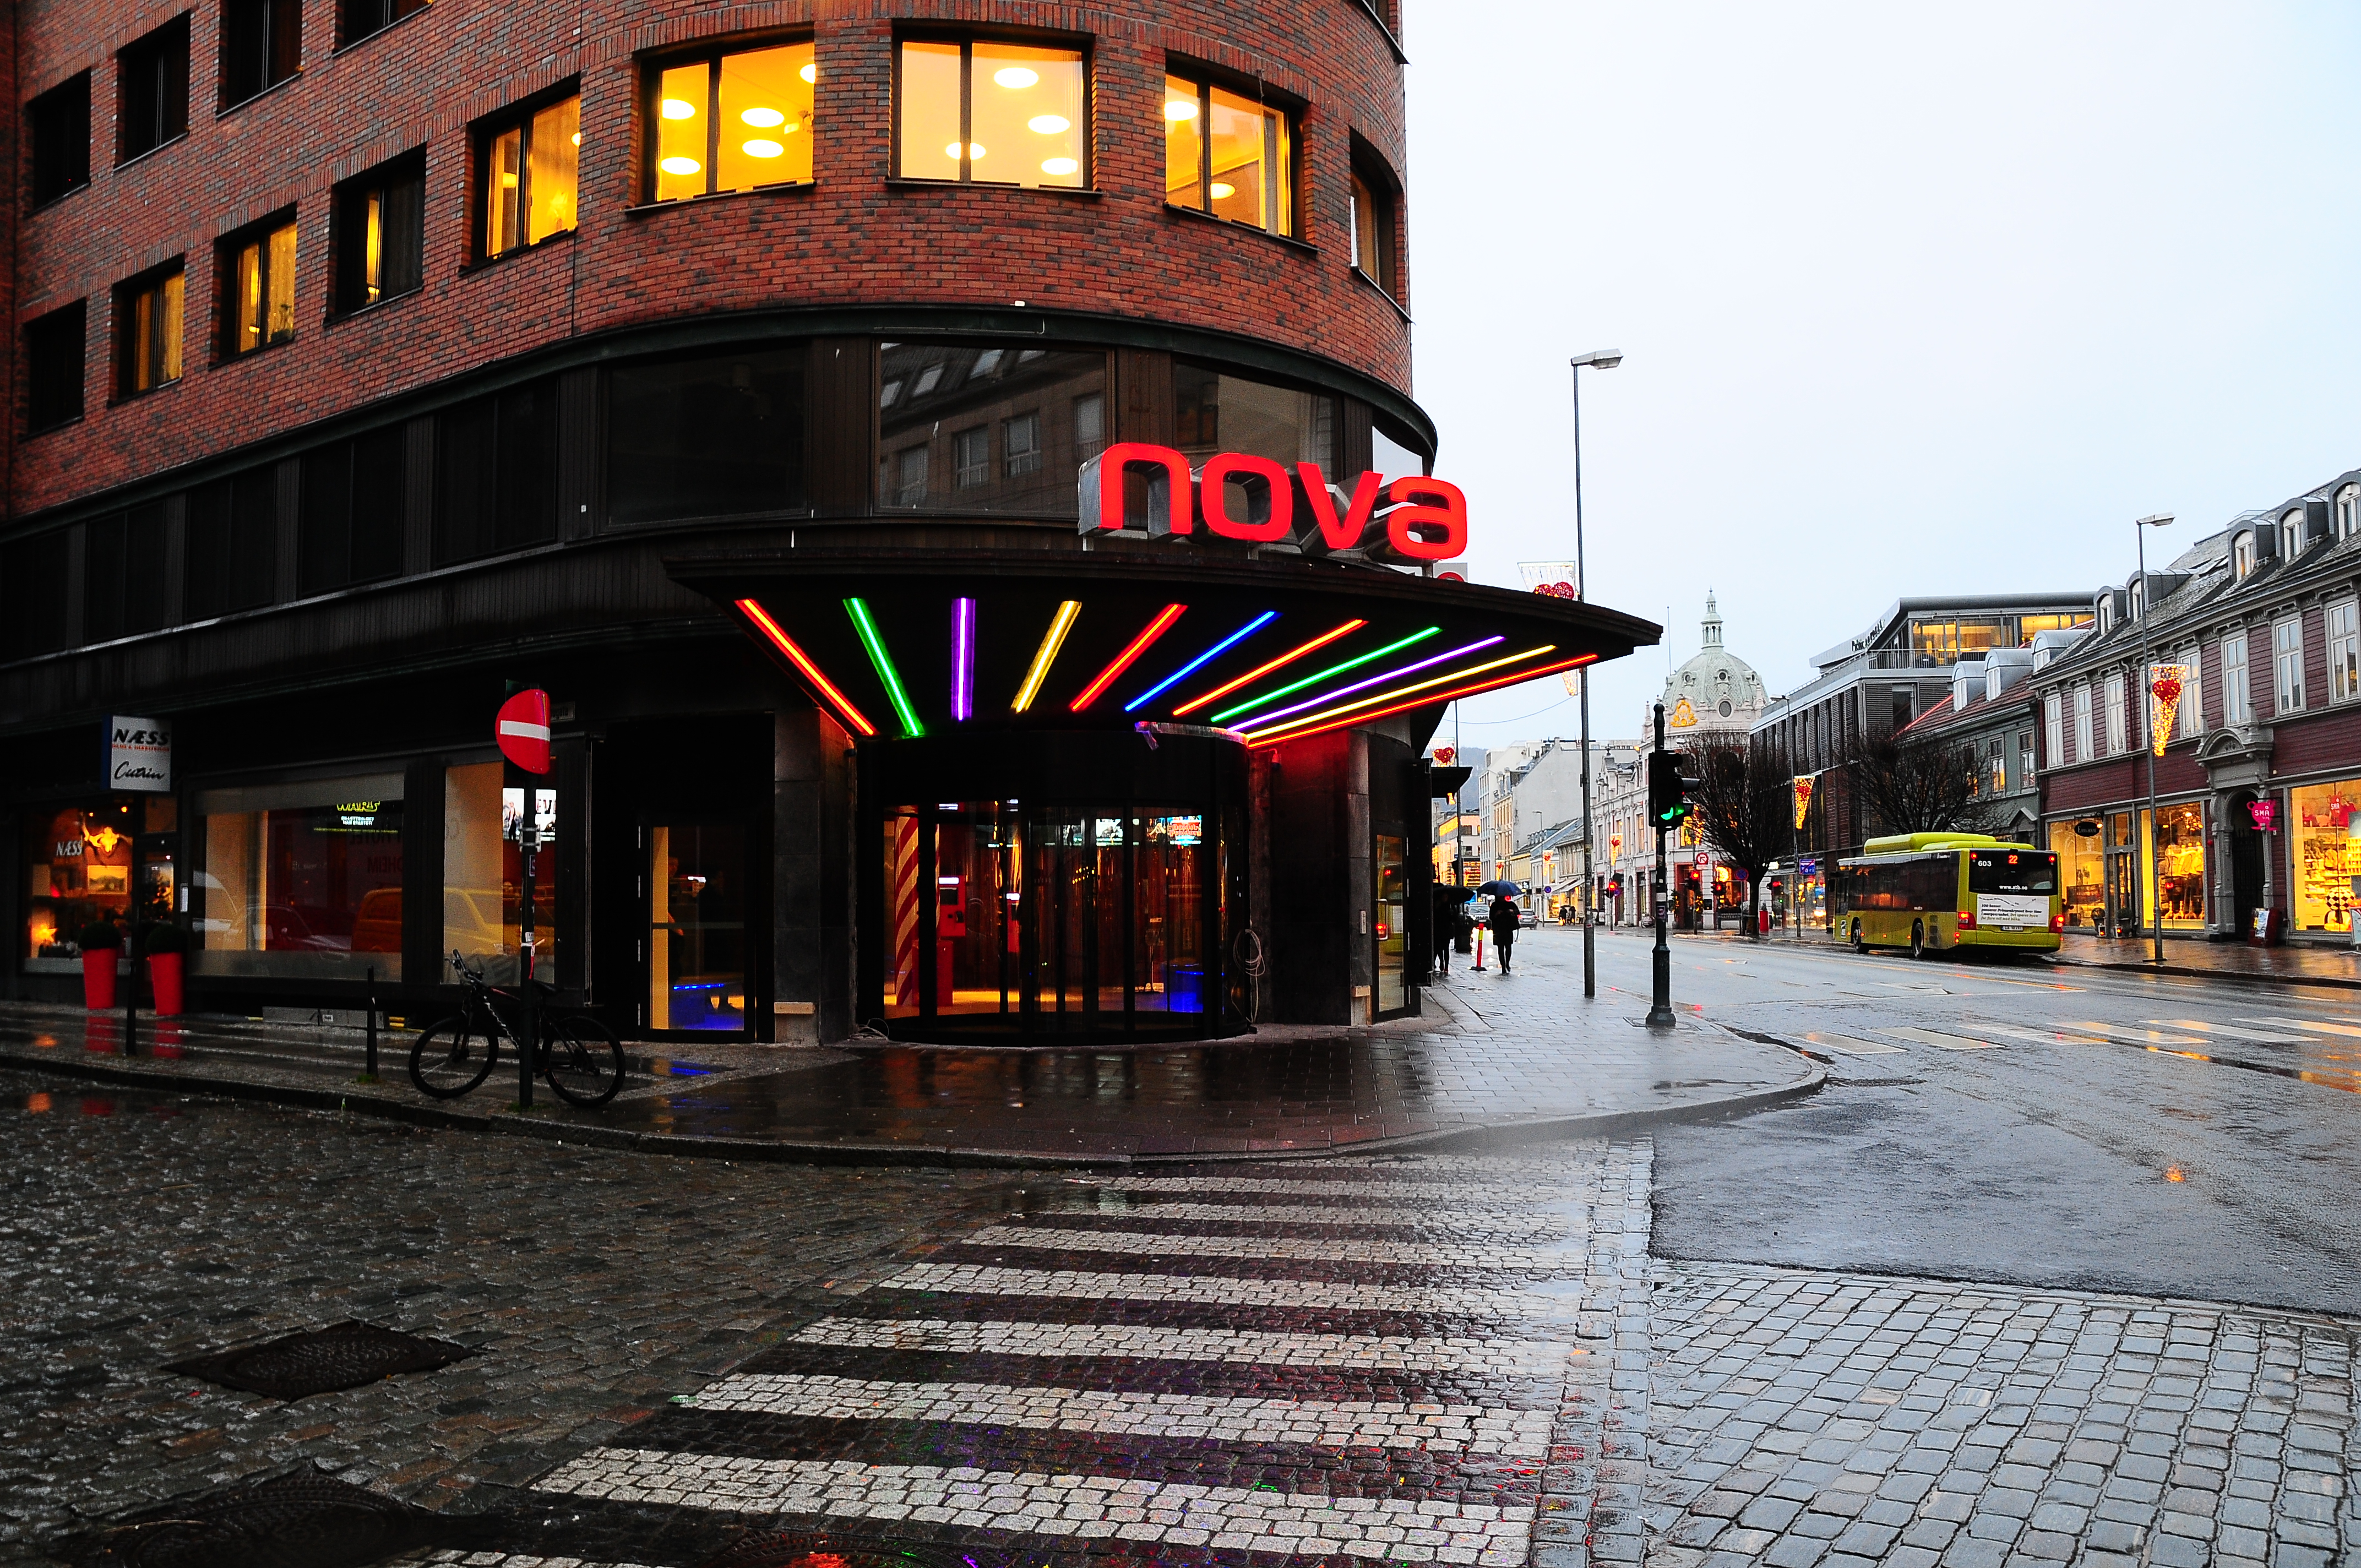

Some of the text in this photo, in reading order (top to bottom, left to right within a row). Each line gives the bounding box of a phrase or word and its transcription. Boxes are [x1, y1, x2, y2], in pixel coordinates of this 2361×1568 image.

[1098, 443, 1468, 559] nova
[113, 728, 170, 745] NÆSS
[114, 760, 165, 780] Cutrin
[2254, 805, 2270, 816] SMÅ
[56, 840, 83, 856] NÆSS
[2009, 855, 2018, 864] 22
